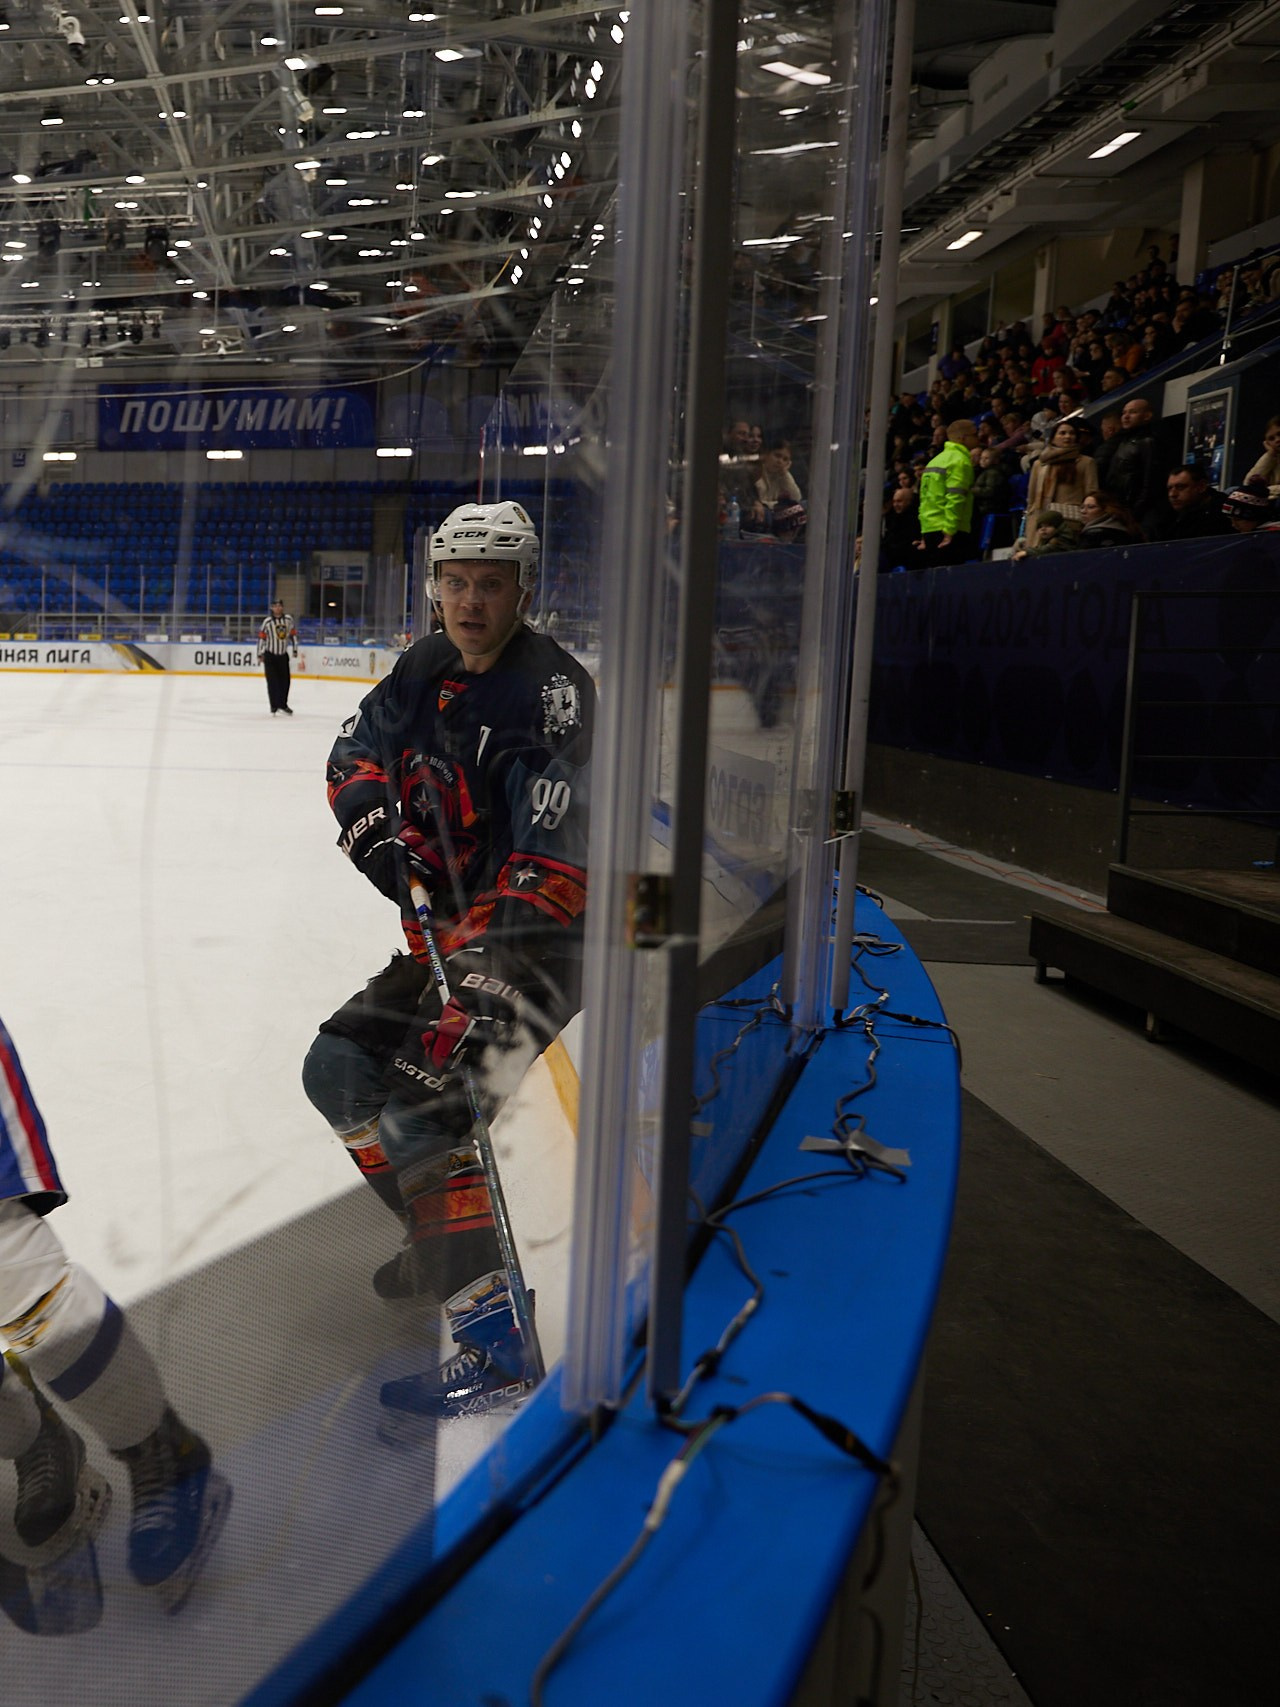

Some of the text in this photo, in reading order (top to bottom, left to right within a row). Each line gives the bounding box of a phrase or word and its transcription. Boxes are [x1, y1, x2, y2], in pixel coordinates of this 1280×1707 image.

[121, 397, 347, 433] ПОШУМИМ!
[453, 530, 488, 539] CCM
[45, 649, 91, 664] ЛИГА
[531, 777, 570, 831] 99
[341, 806, 387, 858] UER
